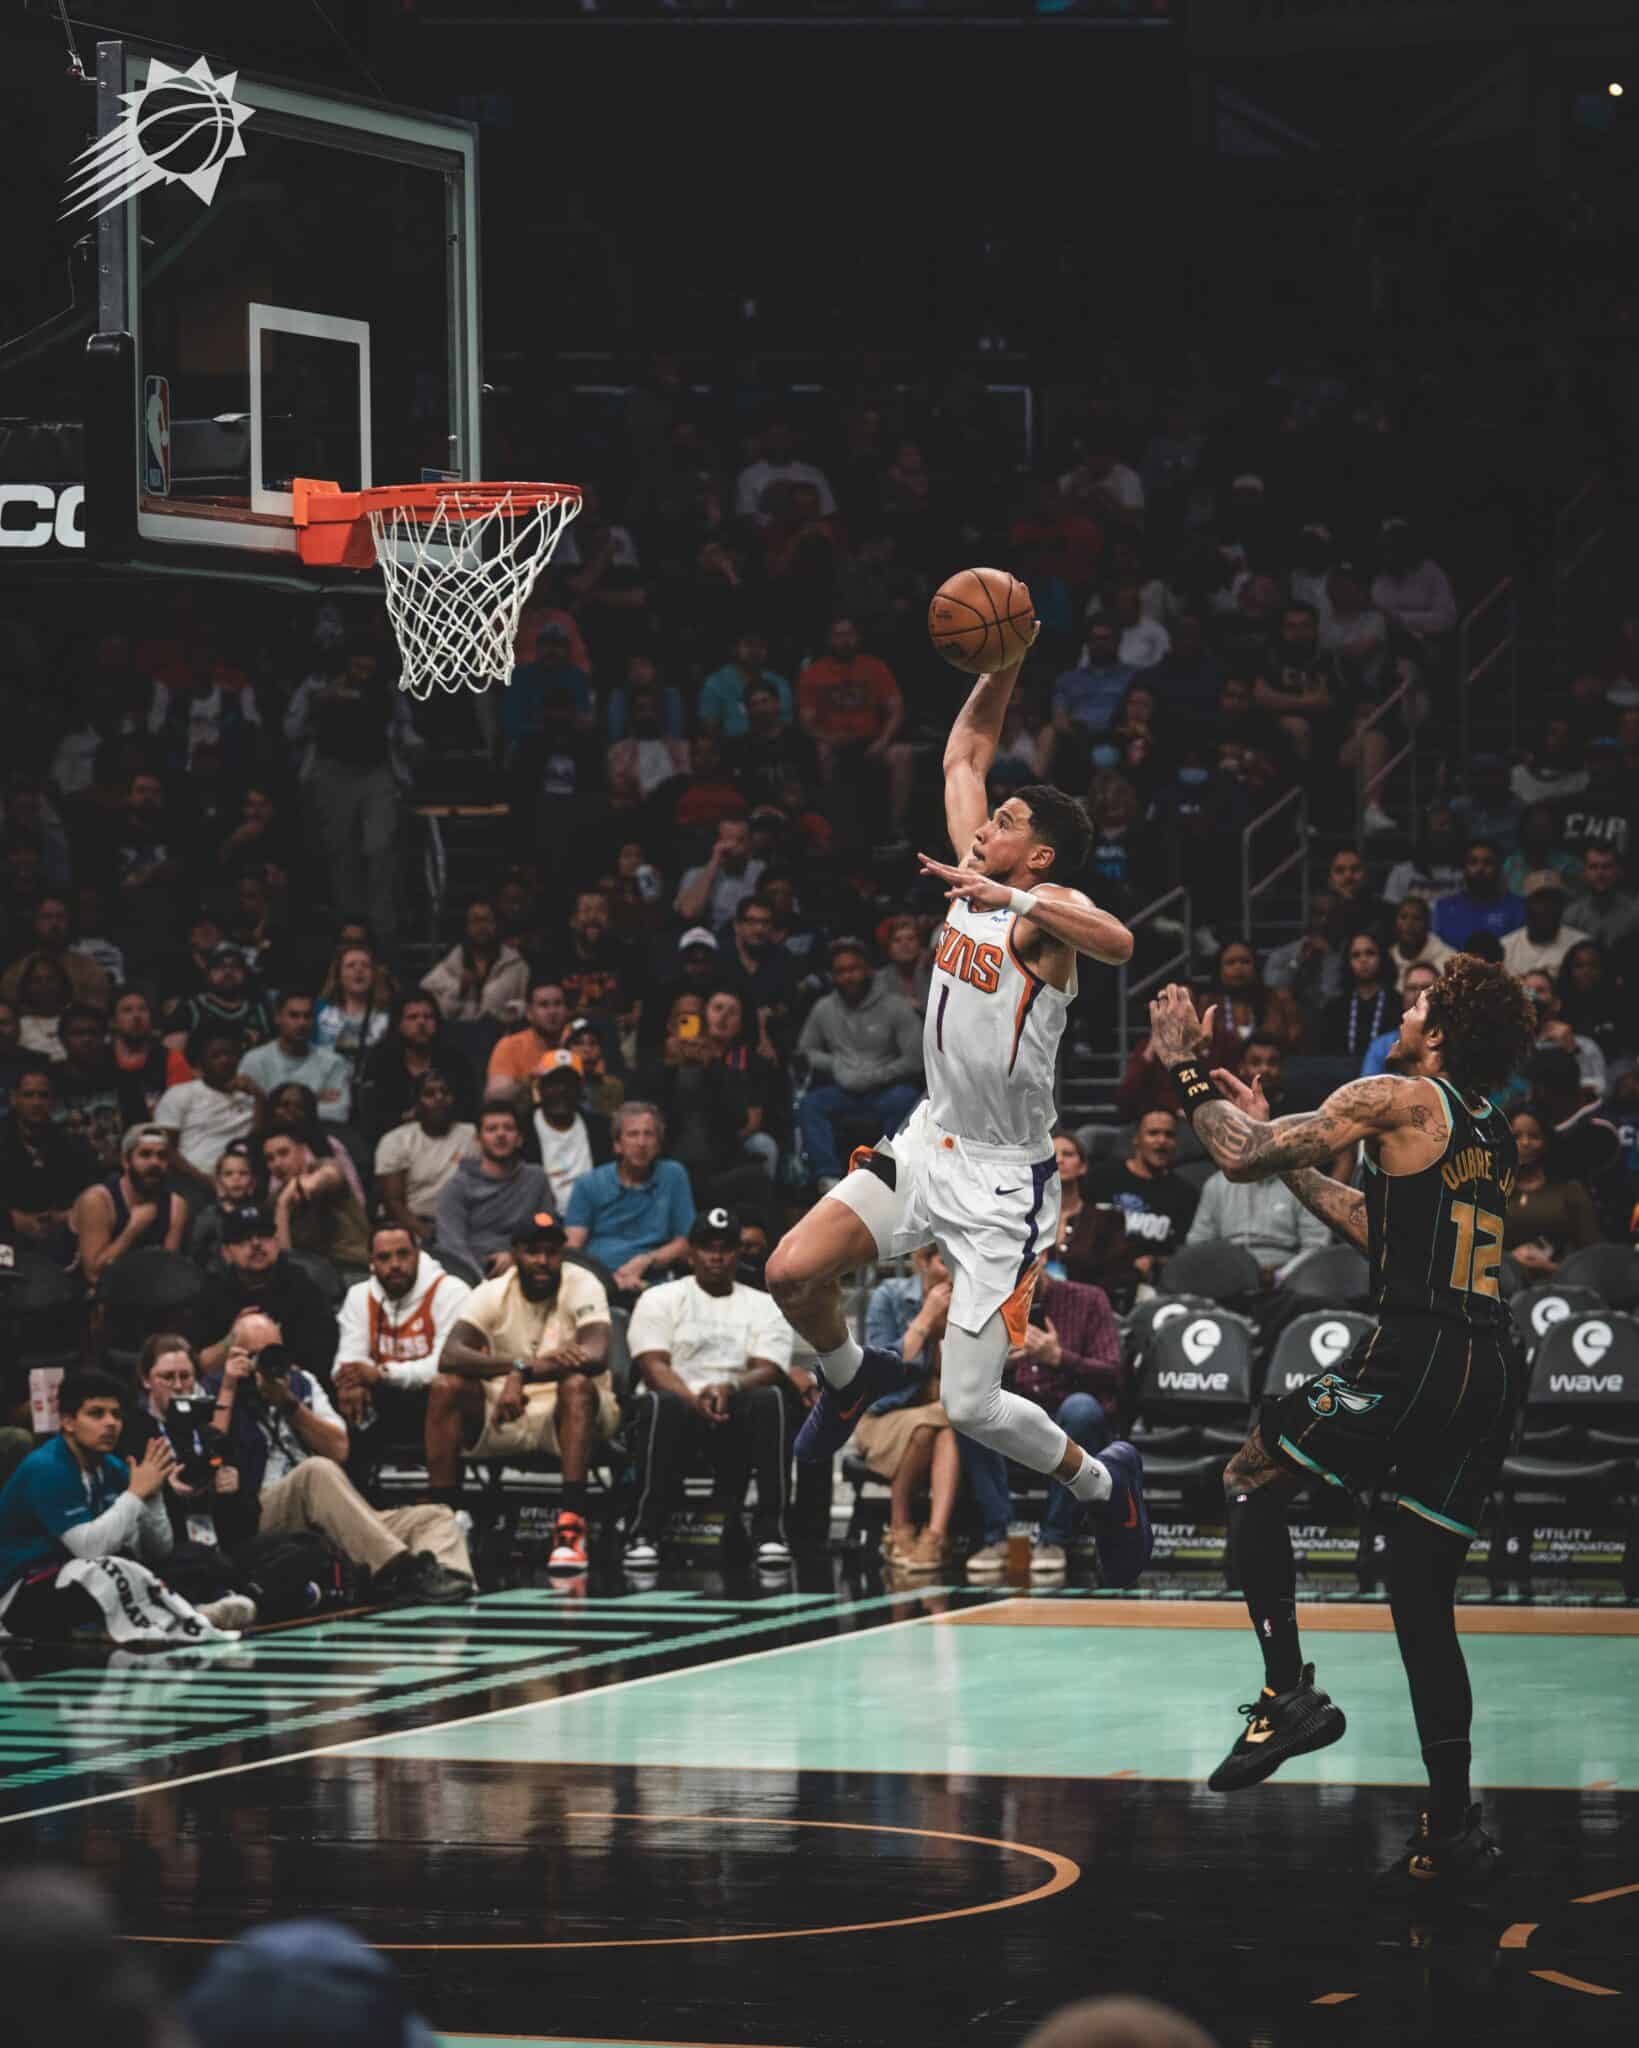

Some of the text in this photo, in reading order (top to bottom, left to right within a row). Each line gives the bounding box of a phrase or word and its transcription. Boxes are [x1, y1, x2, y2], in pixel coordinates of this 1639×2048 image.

[936, 983, 949, 1053] 1
[708, 1207, 729, 1229] C
[1449, 1200, 1505, 1302] 12
[1157, 1371, 1230, 1391] wave
[1549, 1373, 1624, 1392] wave
[1150, 1523, 1196, 1537] TILITY
[1532, 1528, 1593, 1540] UTILITY
[1373, 1535, 1386, 1552] 5
[1506, 1538, 1519, 1554] 6
[1549, 1541, 1627, 1553] INNOVATION
